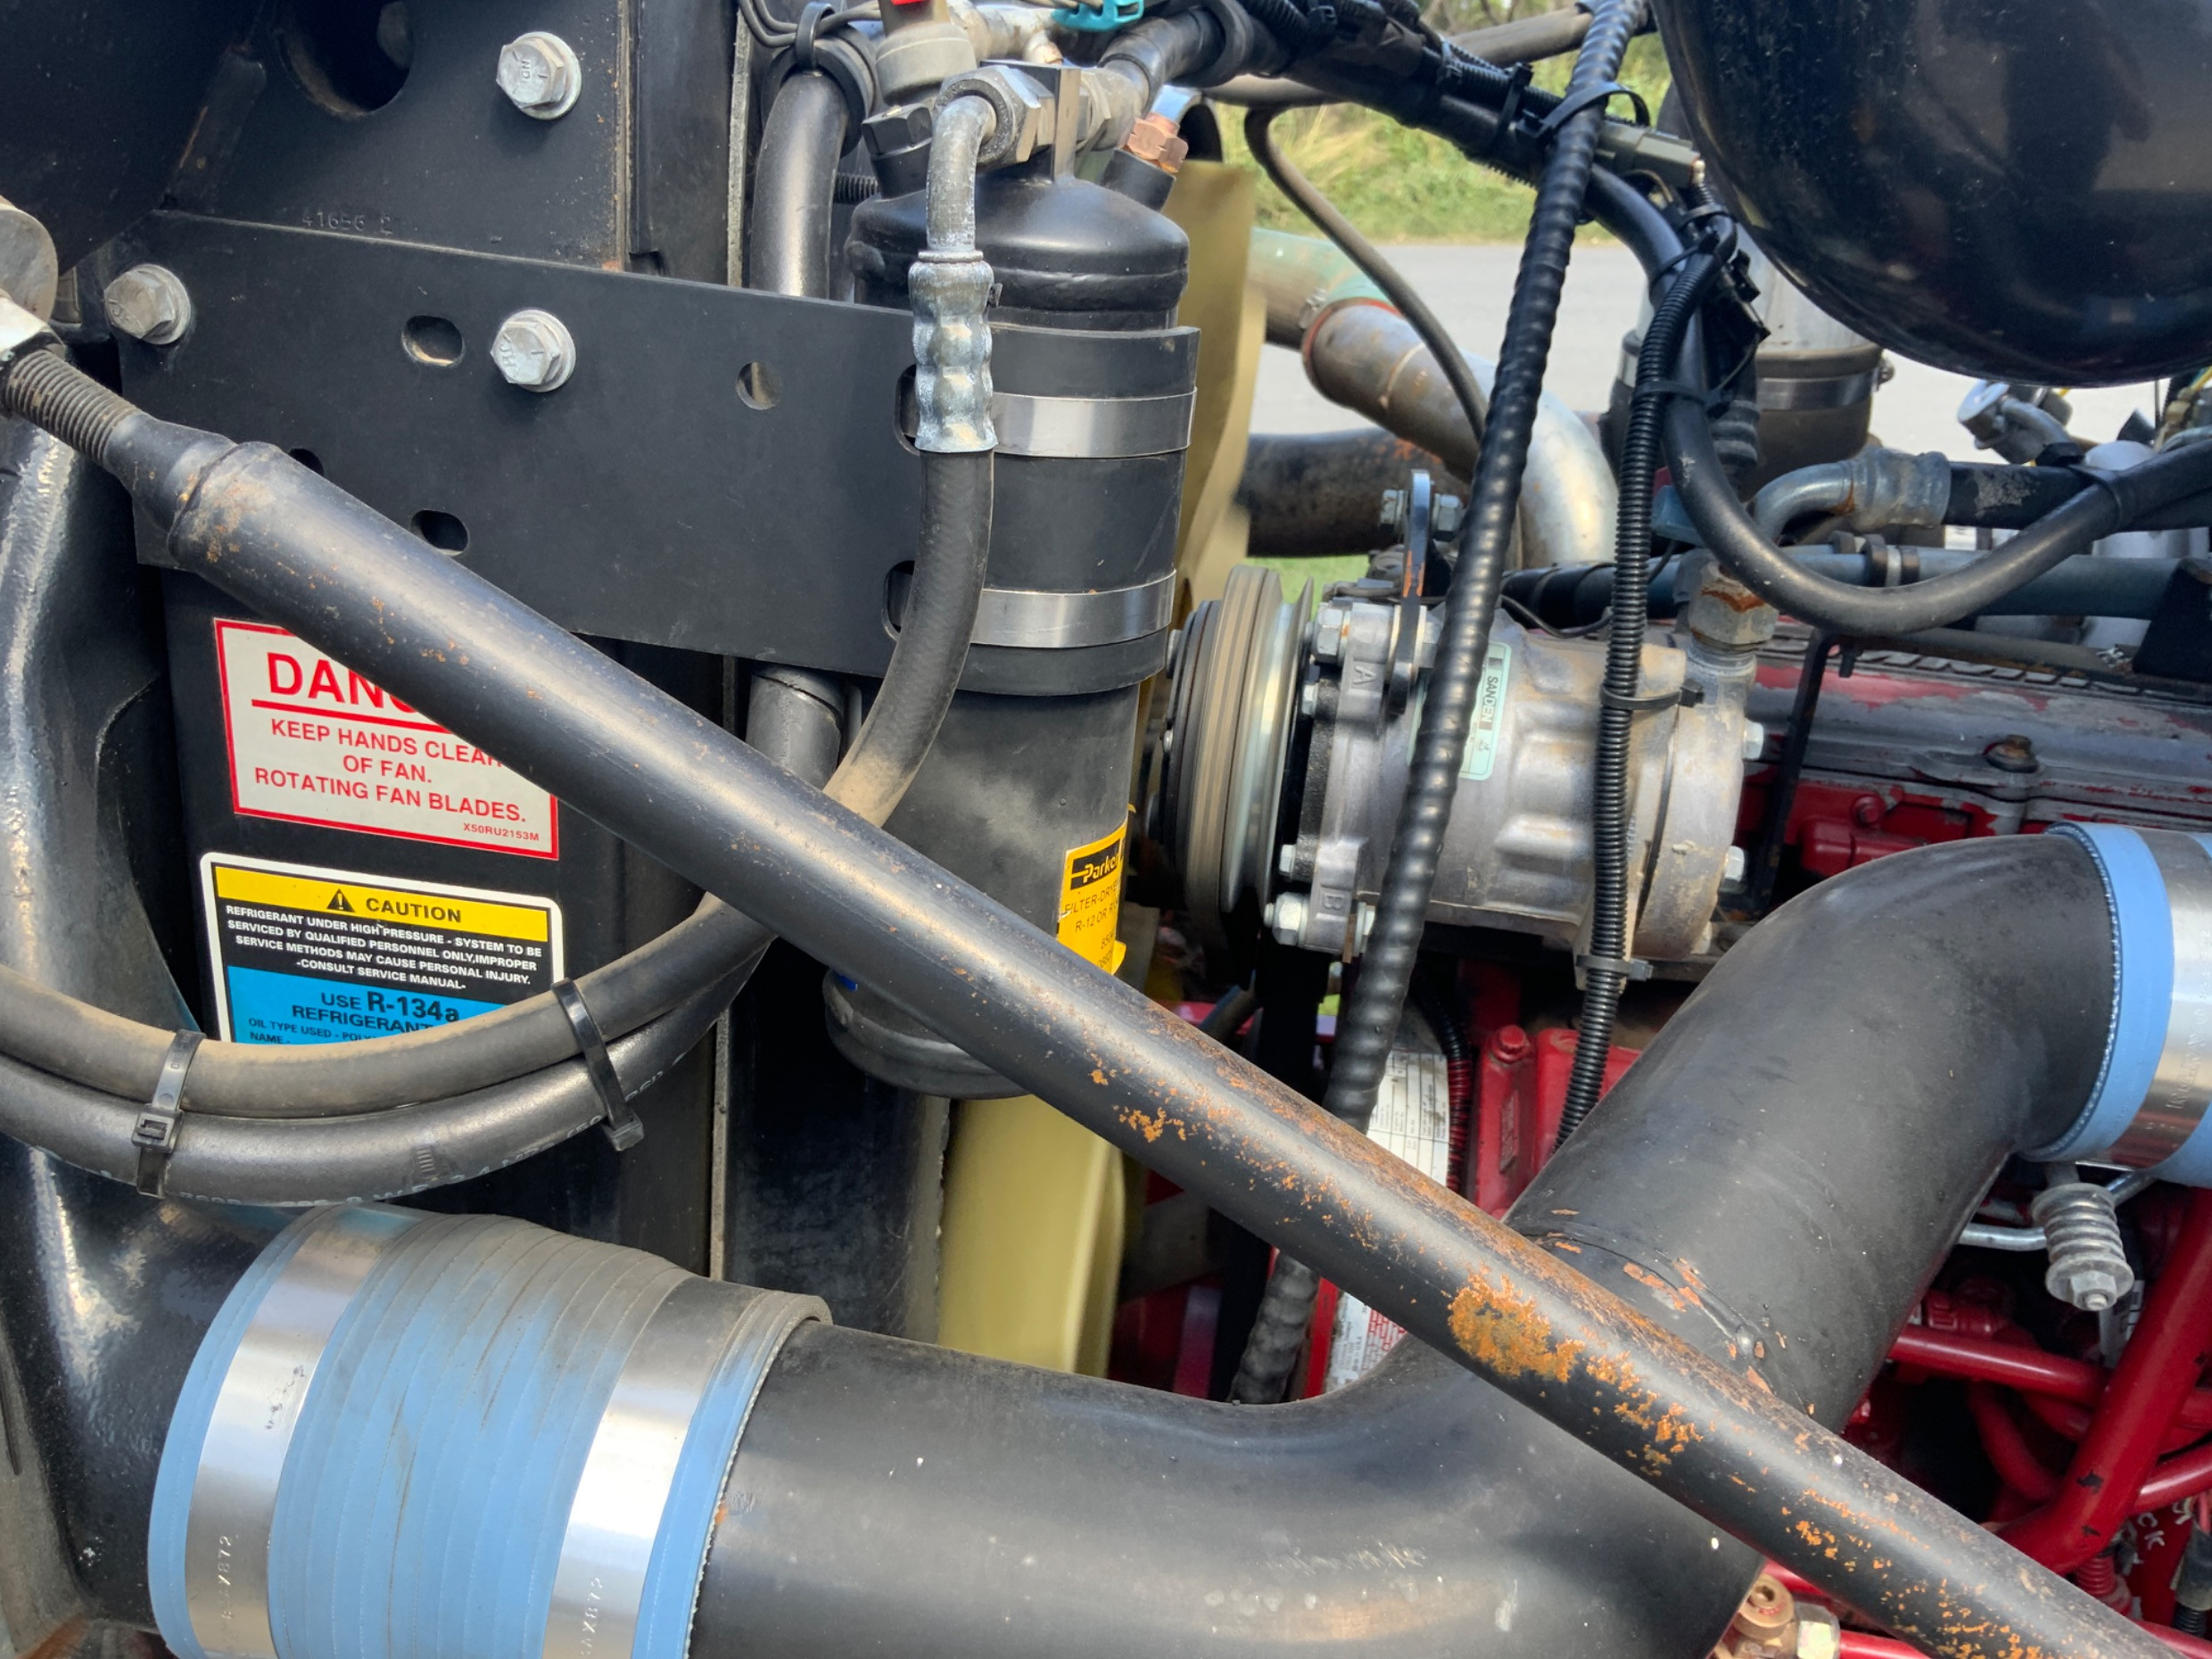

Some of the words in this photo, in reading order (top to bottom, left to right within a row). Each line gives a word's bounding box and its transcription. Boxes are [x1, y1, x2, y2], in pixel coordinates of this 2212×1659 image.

[268, 652, 418, 713] DAN
[1481, 675, 1498, 723] SANDEN
[272, 718, 331, 742] KEEP
[338, 728, 417, 755] HANDS
[343, 755, 373, 774] OF
[382, 762, 432, 783] FAN.
[255, 767, 368, 799] ROTATING
[376, 784, 421, 808] FAN
[429, 793, 526, 823] BLADES.
[366, 897, 461, 923] CAUTION
[227, 905, 303, 925] REFRIGERANT
[307, 916, 348, 931] UNDER
[351, 922, 379, 935] HIGH
[382, 927, 444, 945] PRESSURE
[455, 937, 504, 953] SYSTEM
[508, 944, 524, 955] TO
[527, 945, 542, 957] BE
[227, 920, 284, 937] SERVICED
[286, 928, 301, 939] BY
[304, 931, 366, 948] QUALIFIED
[369, 939, 440, 958] PERSONNEL
[235, 936, 284, 951] SERVICE
[286, 942, 343, 959] METHODS
[346, 950, 373, 963] MAY
[376, 954, 417, 970] CAUSE
[419, 960, 483, 978] PERSONAL
[485, 969, 531, 985] INJURY.
[358, 965, 408, 982] SERVICE
[321, 992, 367, 1011] USE
[367, 990, 459, 1023] R-134a
[249, 1019, 268, 1030] OIL
[270, 1021, 299, 1033] TYPE
[301, 1025, 332, 1037] USED
